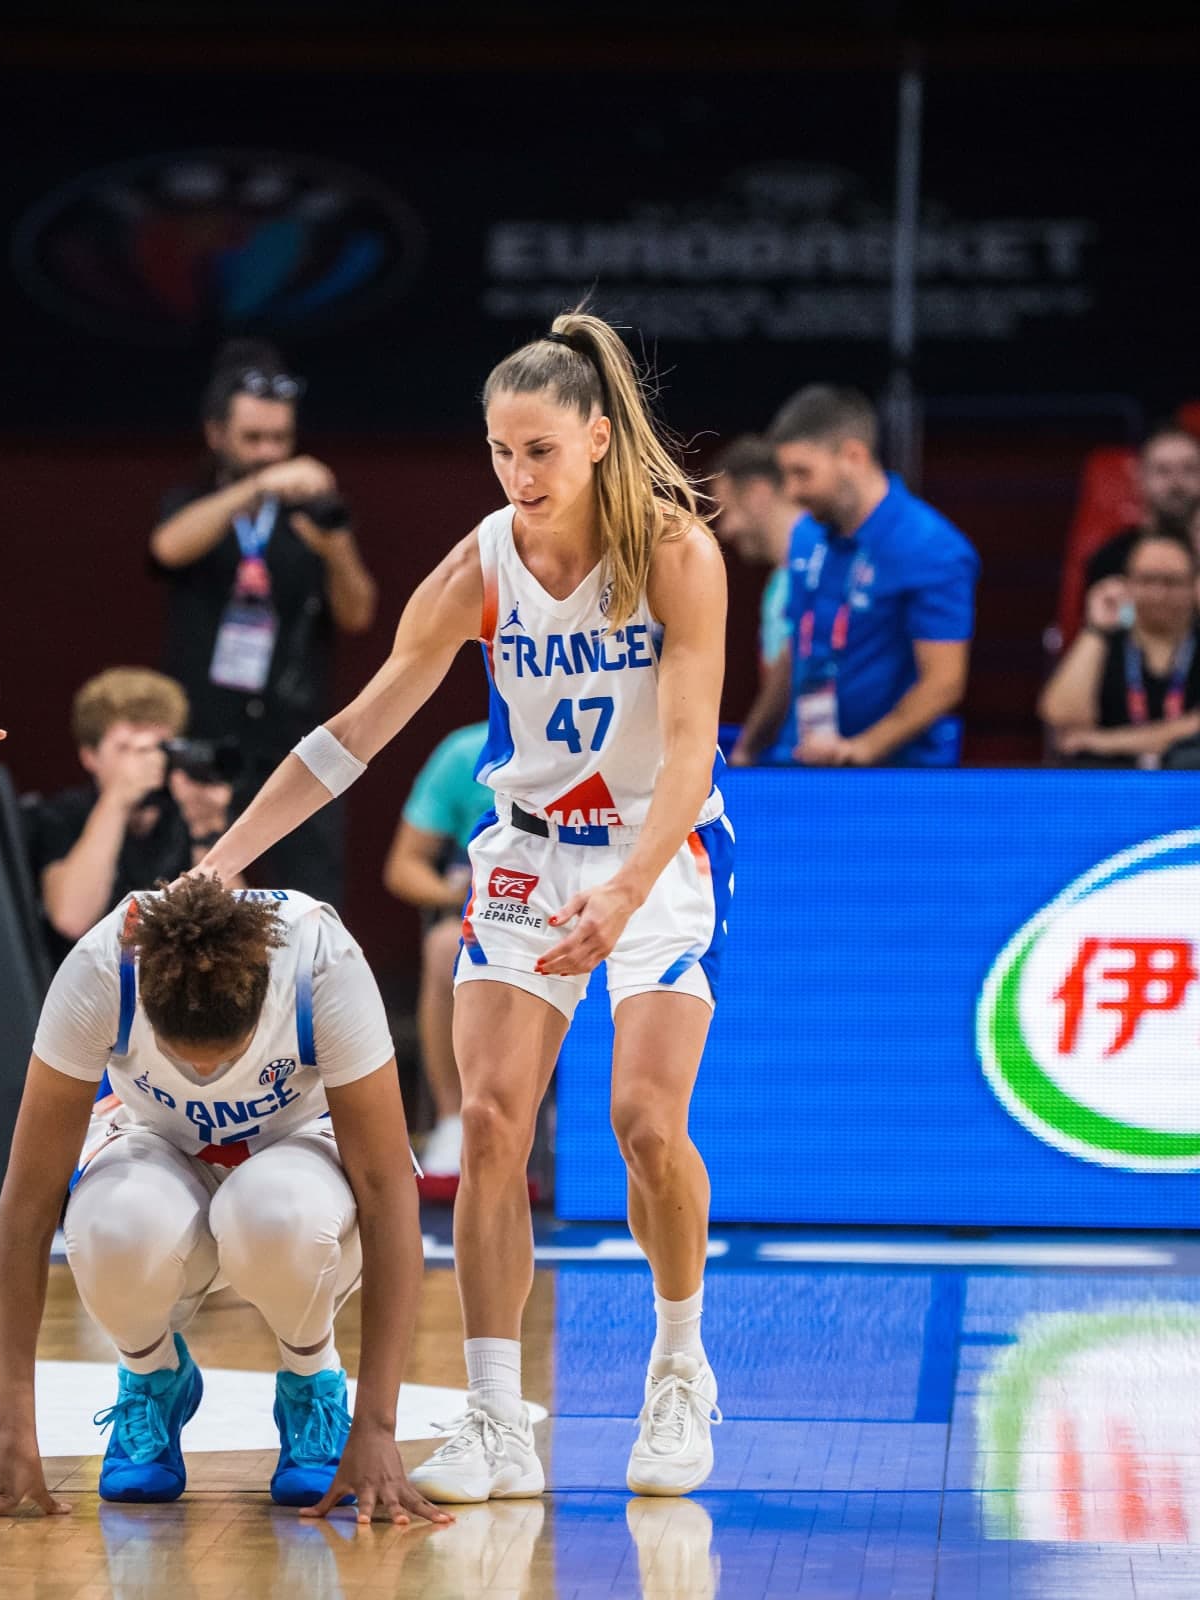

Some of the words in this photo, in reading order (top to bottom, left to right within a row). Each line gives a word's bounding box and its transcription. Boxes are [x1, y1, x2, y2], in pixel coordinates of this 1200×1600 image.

[500, 624, 652, 678] FRANCE
[545, 696, 614, 753] 47
[488, 901, 531, 915] CAISSE
